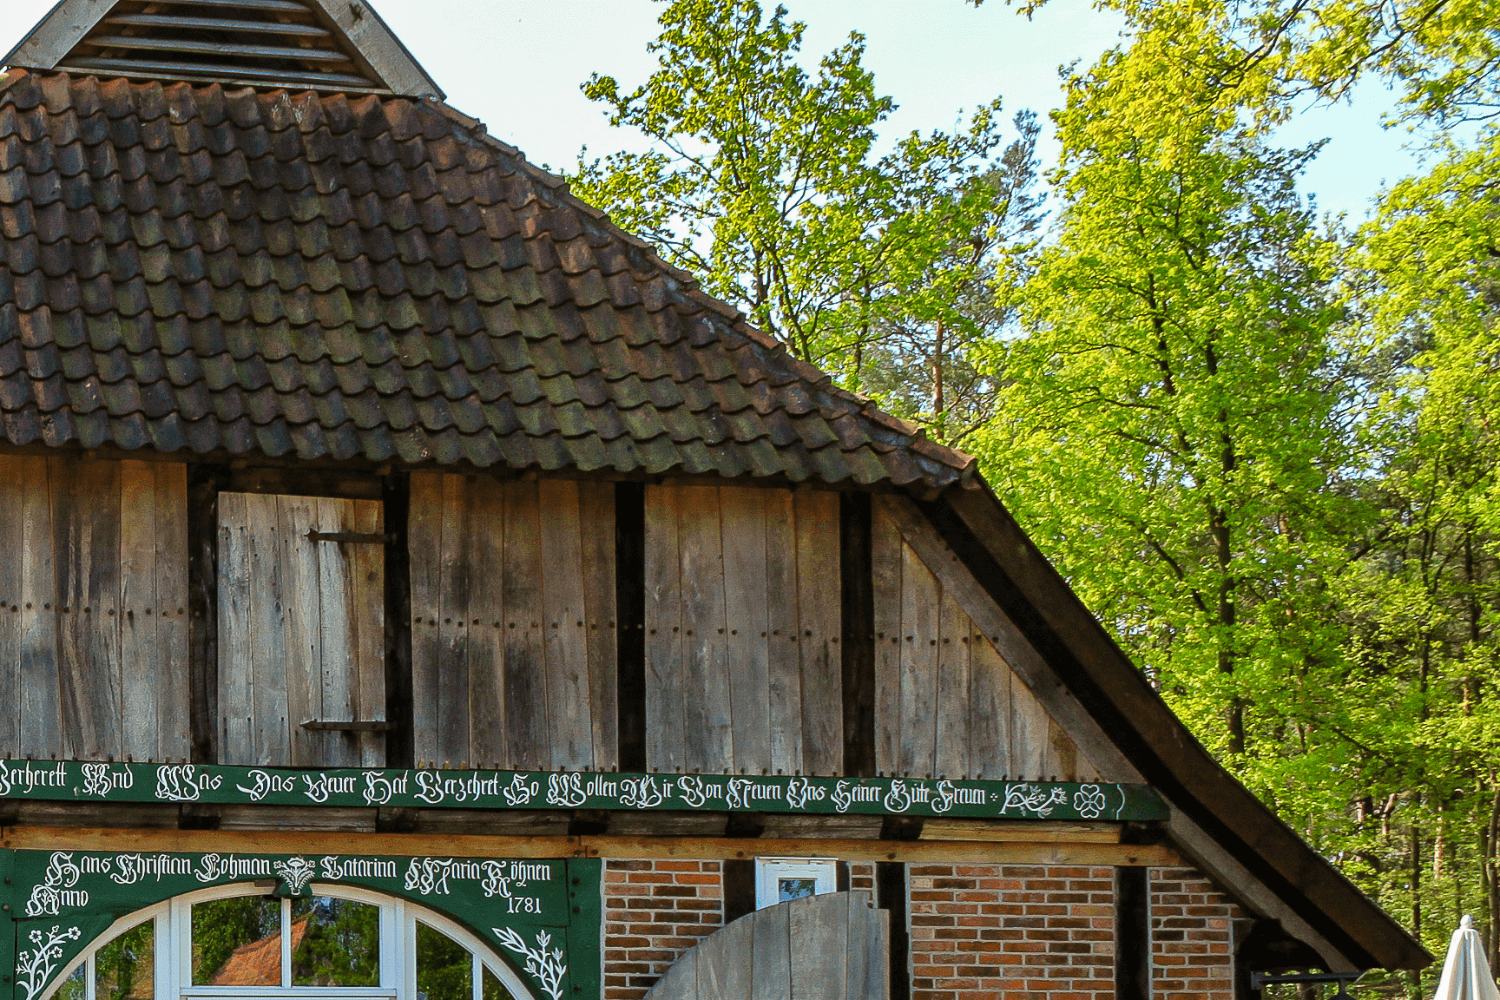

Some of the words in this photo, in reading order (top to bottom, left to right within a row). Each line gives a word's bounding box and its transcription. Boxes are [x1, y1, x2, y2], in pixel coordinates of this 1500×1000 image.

[677, 776, 722, 807] Von
[45, 851, 113, 888] Hans
[507, 897, 542, 913] 1781
